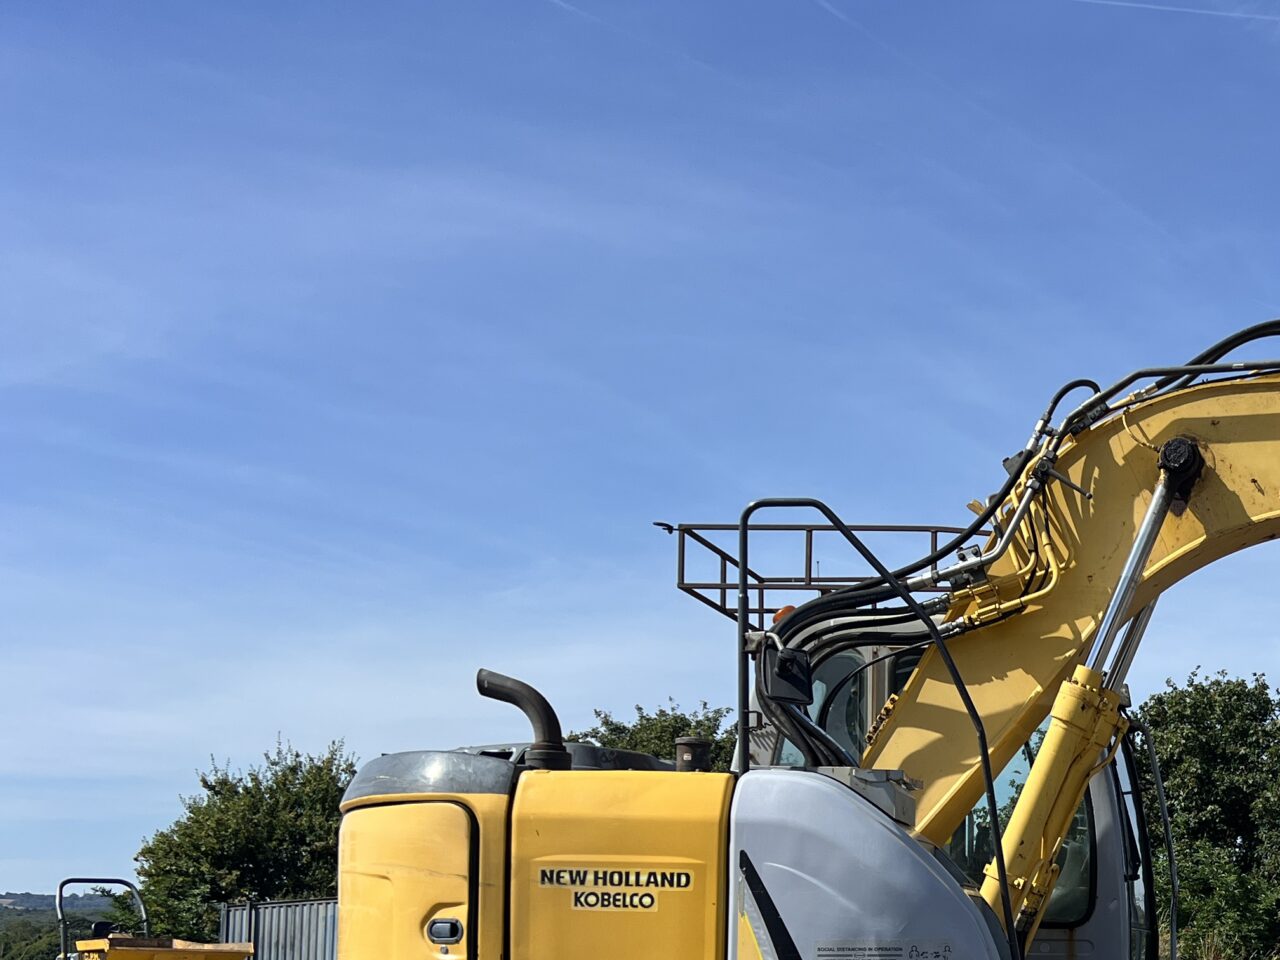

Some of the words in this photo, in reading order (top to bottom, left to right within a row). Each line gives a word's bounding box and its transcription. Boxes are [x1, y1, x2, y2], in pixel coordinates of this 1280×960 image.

[540, 869, 588, 885] NEW
[593, 870, 691, 889] HOLLAND
[573, 891, 655, 909] KOBELCO
